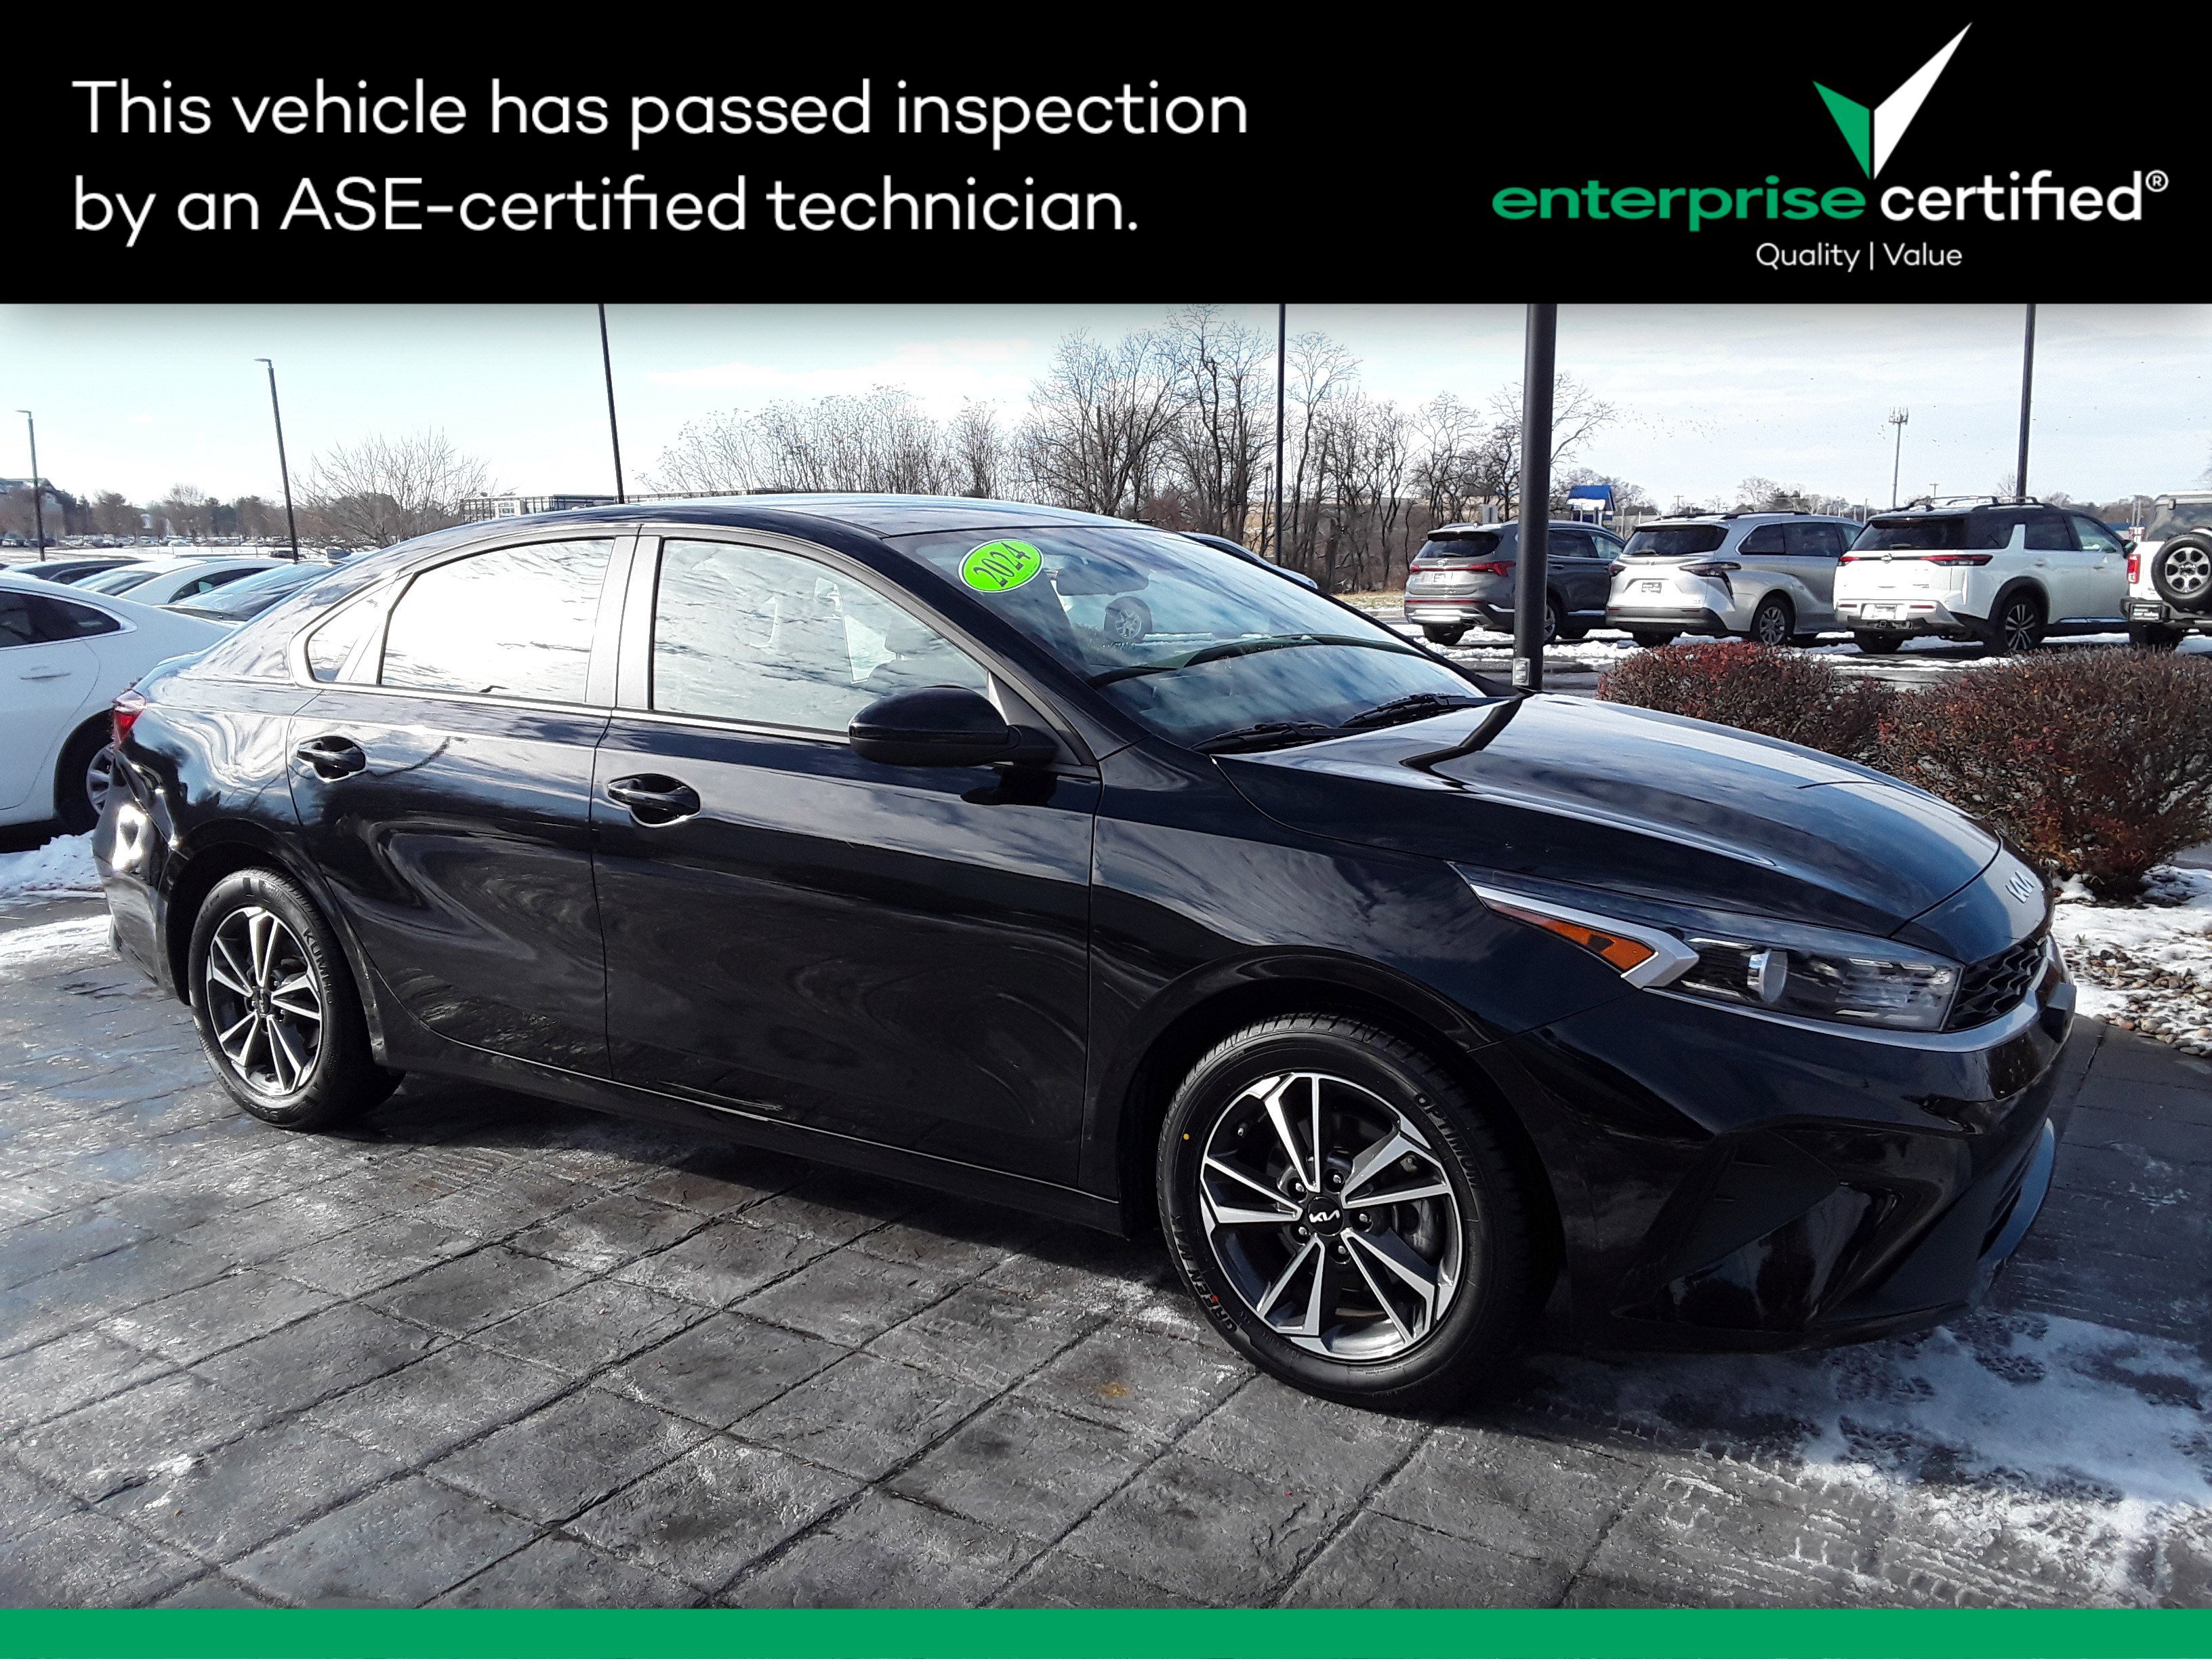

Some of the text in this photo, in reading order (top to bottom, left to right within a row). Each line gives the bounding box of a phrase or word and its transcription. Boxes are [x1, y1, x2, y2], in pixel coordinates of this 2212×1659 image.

[973, 542, 1031, 587] 2024
[302, 928, 333, 1004] KUMHO
[1414, 1092, 1479, 1187] OPTIMUM
[1188, 1268, 1237, 1332] GREEN
